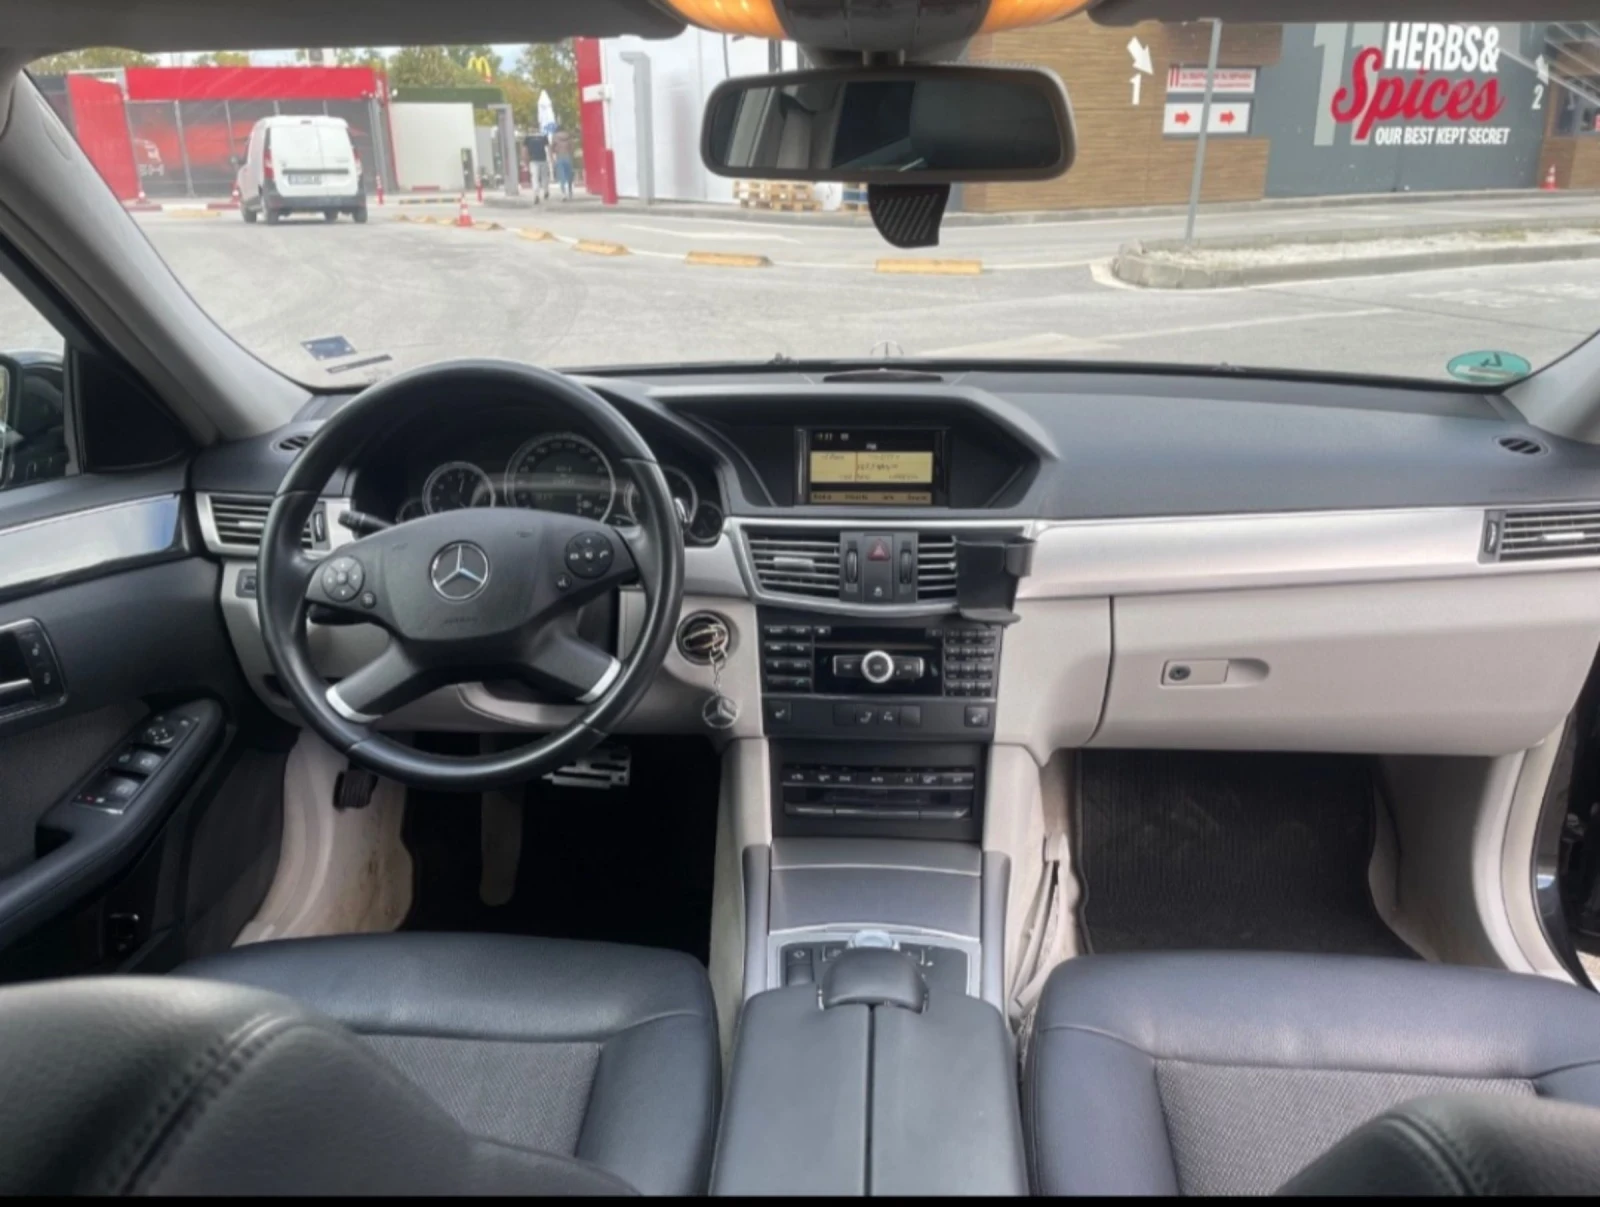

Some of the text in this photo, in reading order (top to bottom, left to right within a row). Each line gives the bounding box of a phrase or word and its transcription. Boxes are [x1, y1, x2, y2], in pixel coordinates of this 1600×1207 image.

[1129, 73, 1141, 105] 1
[1330, 46, 1507, 141] Spices
[1531, 83, 1544, 110] 2
[1375, 127, 1511, 145] OUR BEST KEPT SECRET
